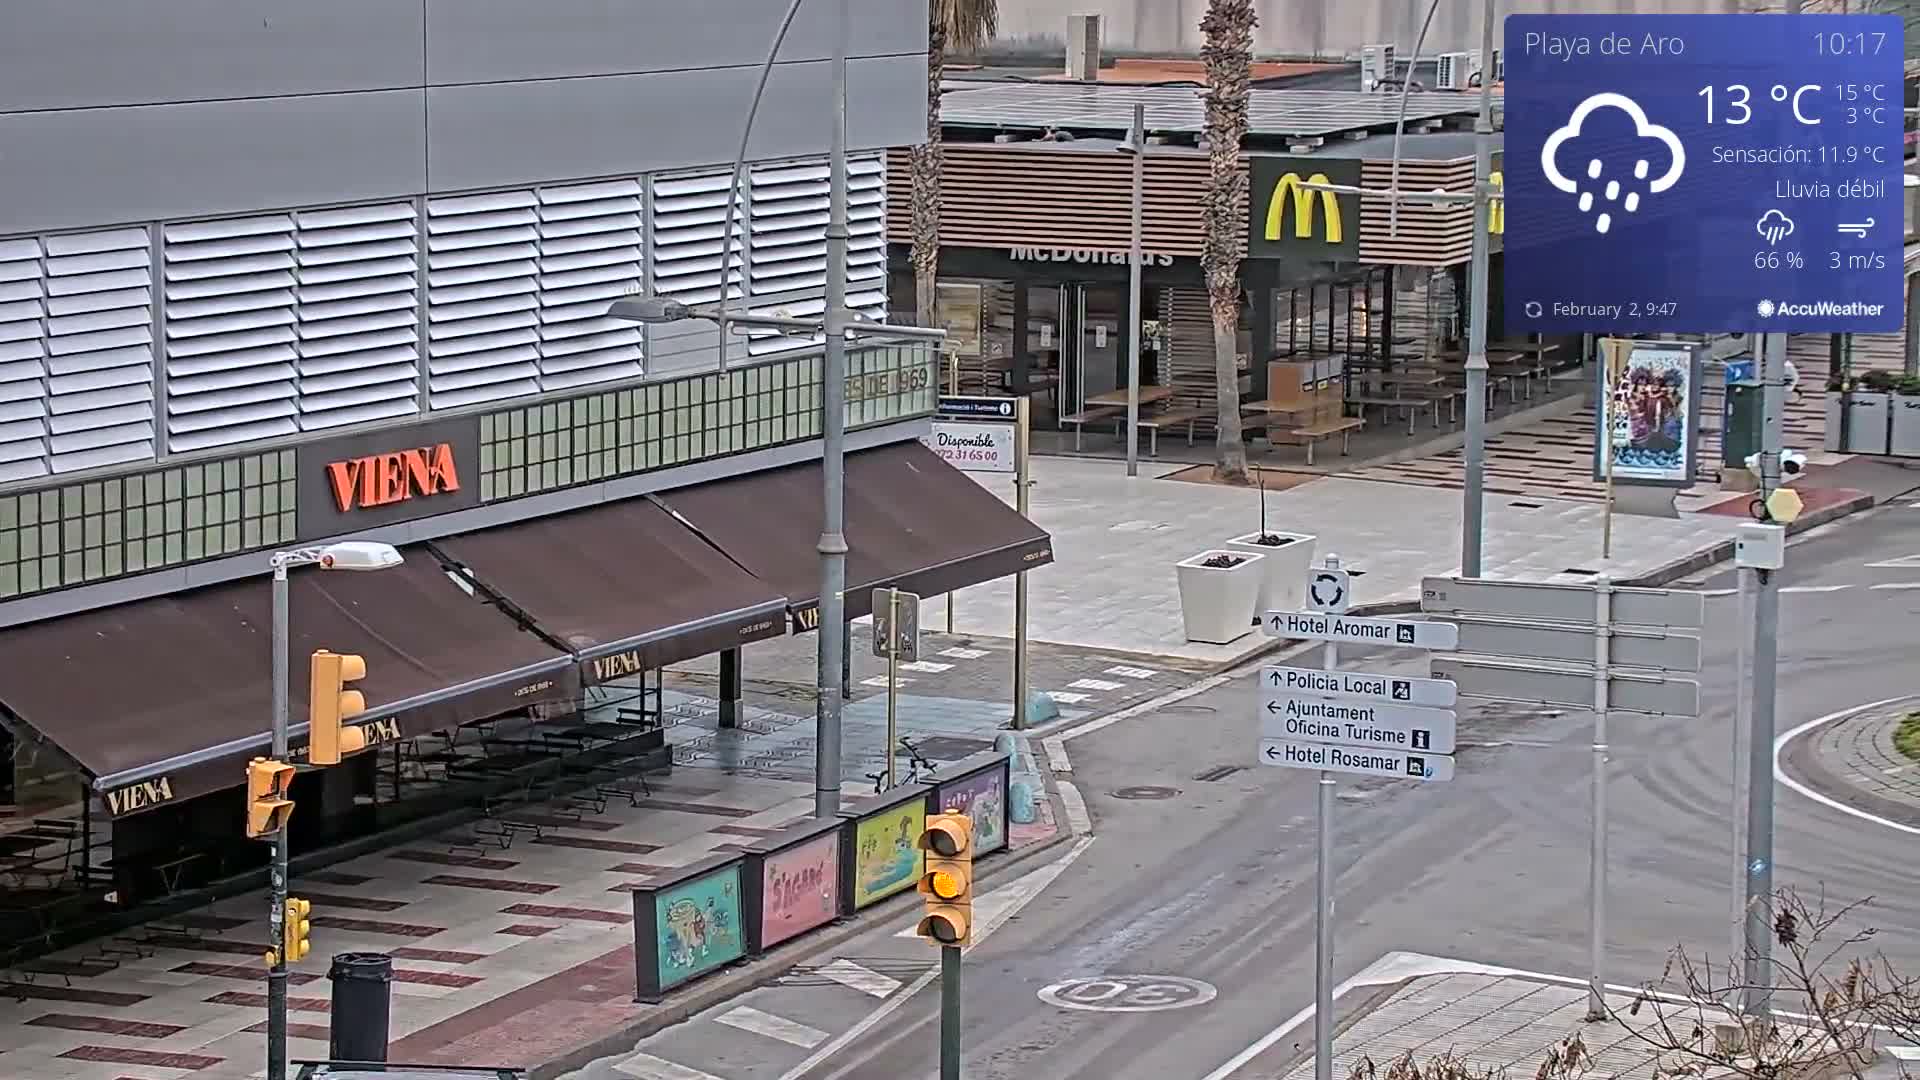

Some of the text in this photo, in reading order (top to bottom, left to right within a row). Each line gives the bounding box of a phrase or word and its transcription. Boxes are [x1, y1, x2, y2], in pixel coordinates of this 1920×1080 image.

[937, 432, 995, 449] Disponible
[955, 450, 967, 460] 31
[985, 451, 998, 461] 00
[327, 443, 461, 512] VIENA
[1288, 615, 1391, 639] Hotel Aromar
[594, 650, 641, 679] VIENA
[1344, 675, 1386, 695] Local
[1286, 699, 1375, 722] Ajuntament
[362, 717, 400, 746] ENA
[1286, 718, 1406, 743] Oficina Turisme
[1285, 745, 1400, 771] Hotel Rosamar
[107, 776, 173, 815] VIENA
